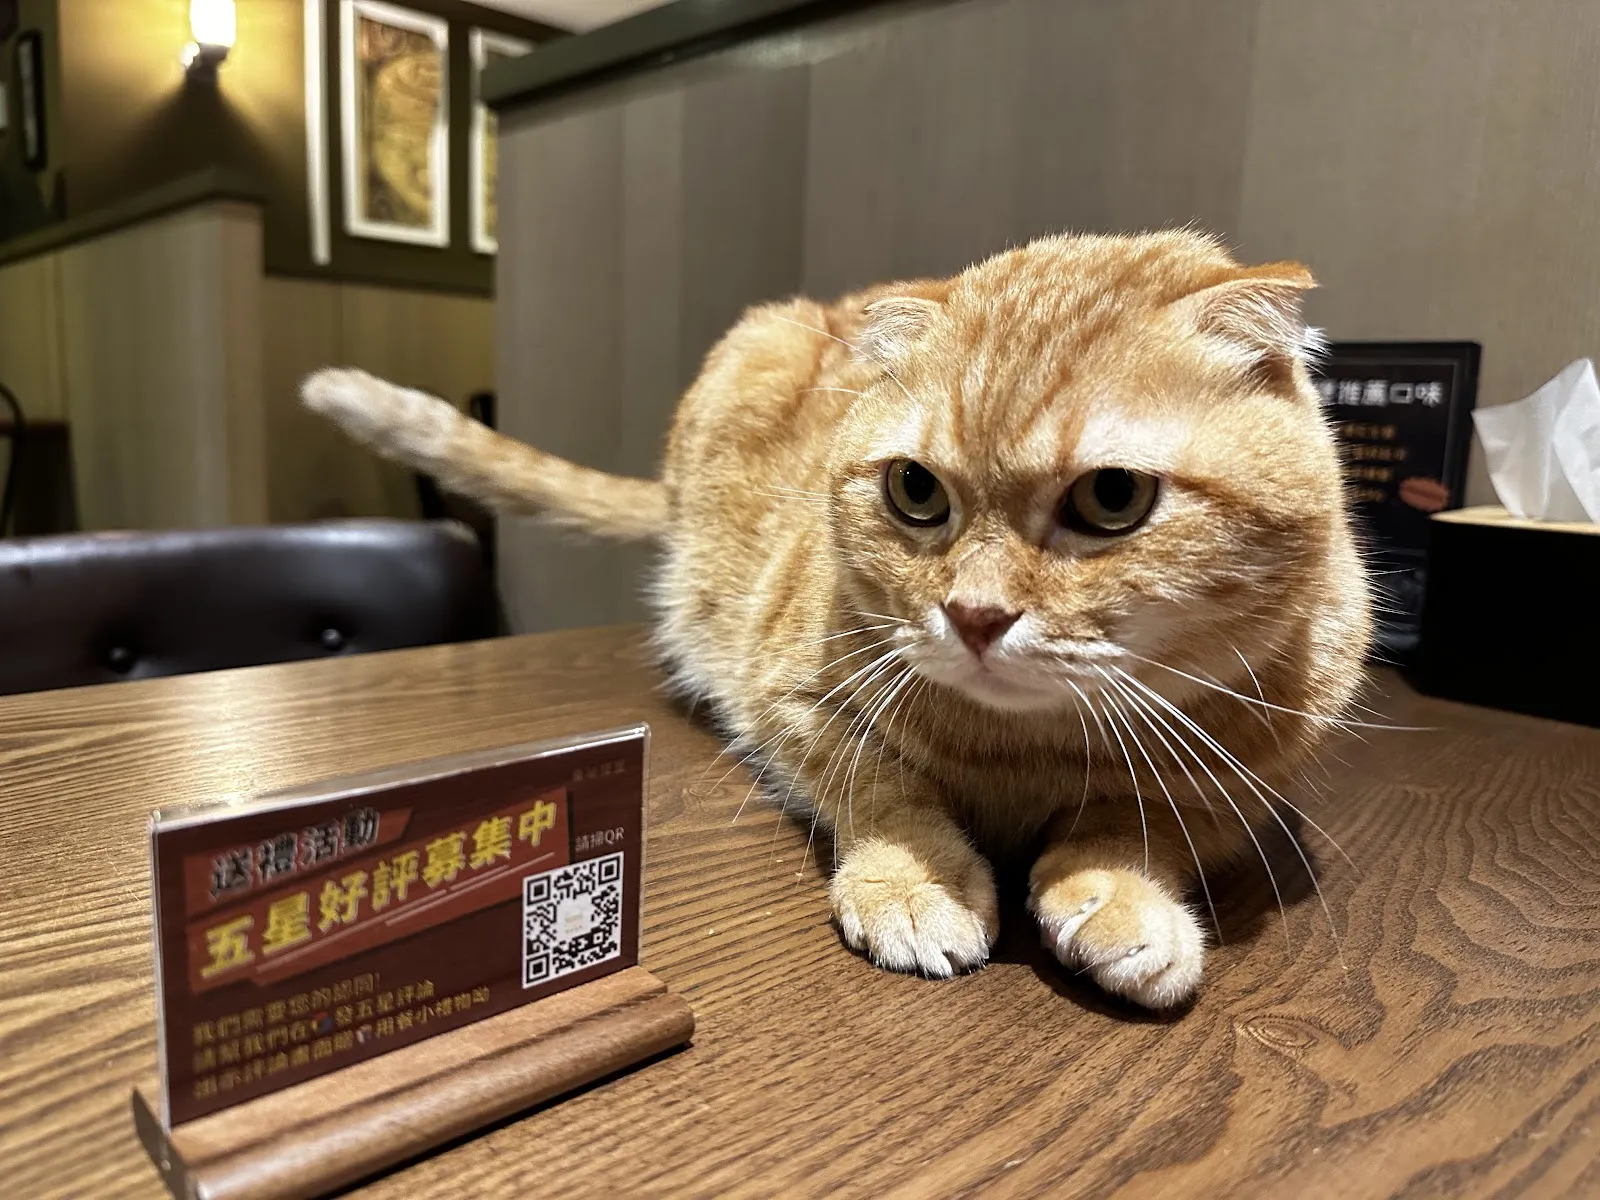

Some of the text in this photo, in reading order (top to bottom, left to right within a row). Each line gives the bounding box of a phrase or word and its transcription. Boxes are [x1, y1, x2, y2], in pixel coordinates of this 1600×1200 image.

[201, 800, 558, 980] 五星好評募集中
[209, 807, 380, 903] 送禮活動
